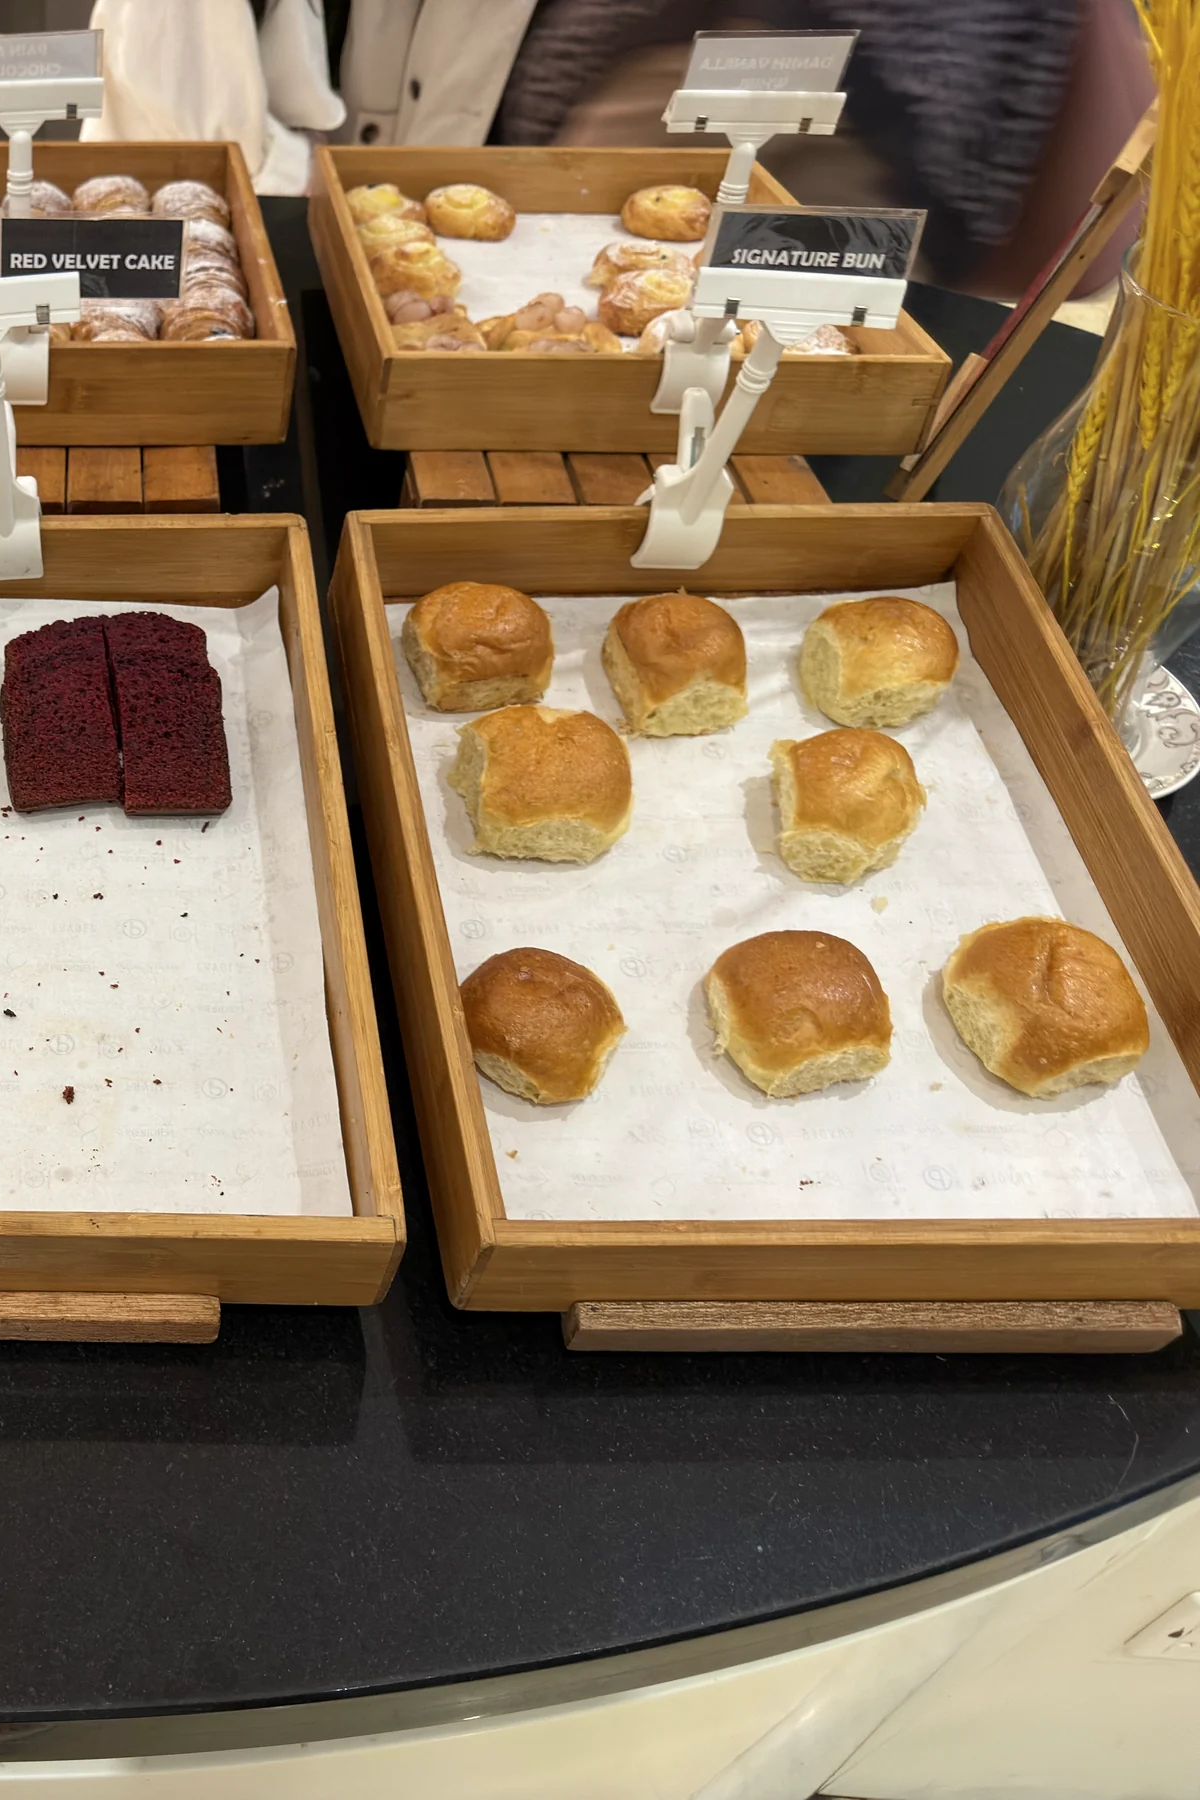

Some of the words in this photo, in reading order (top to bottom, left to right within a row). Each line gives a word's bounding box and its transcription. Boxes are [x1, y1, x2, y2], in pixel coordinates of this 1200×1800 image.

[9, 253, 48, 270] RED
[51, 253, 122, 270] VELVET
[124, 253, 175, 271] CAKE
[730, 247, 839, 269] SIGNATURE
[842, 252, 886, 270] BUN
